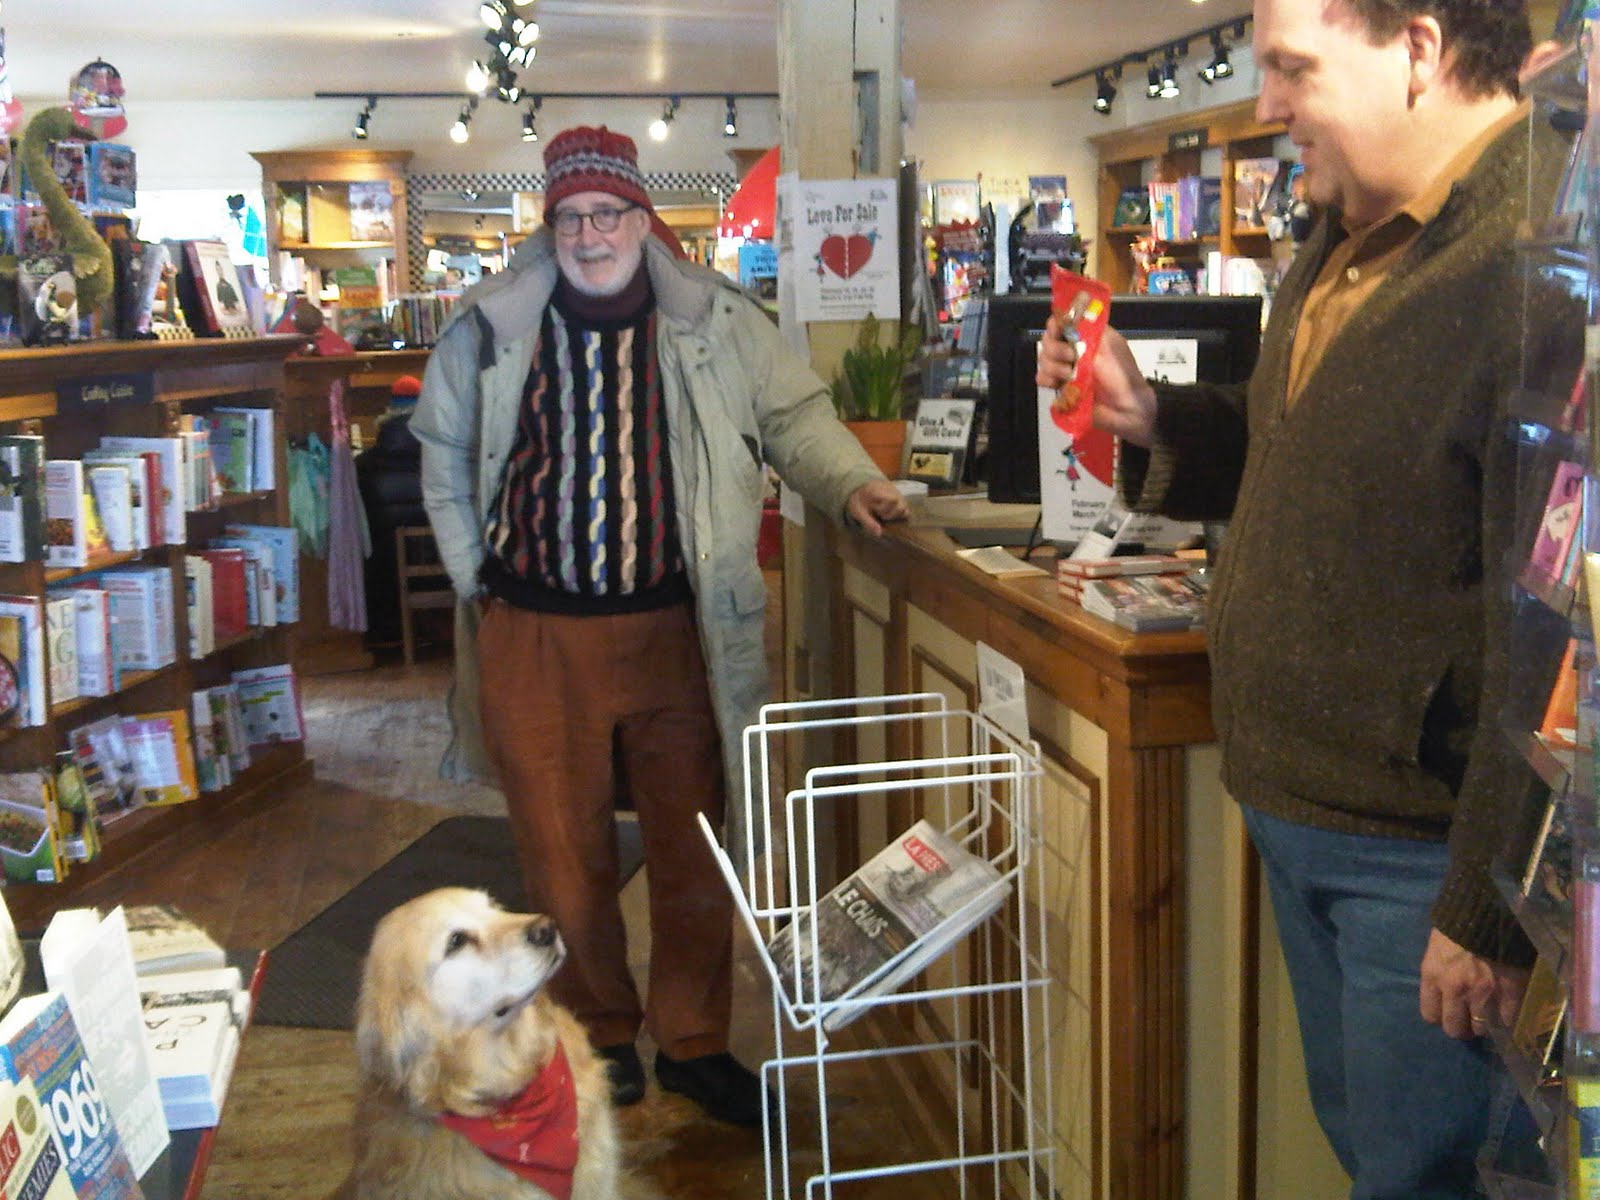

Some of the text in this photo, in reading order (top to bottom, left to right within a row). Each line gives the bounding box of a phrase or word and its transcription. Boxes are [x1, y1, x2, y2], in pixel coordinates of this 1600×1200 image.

[806, 202, 879, 225] Love For Sale
[941, 427, 962, 438] Card
[1072, 500, 1107, 510] February
[1072, 510, 1096, 519] March
[832, 882, 860, 907] LE
[42, 1059, 107, 1166] 1969
